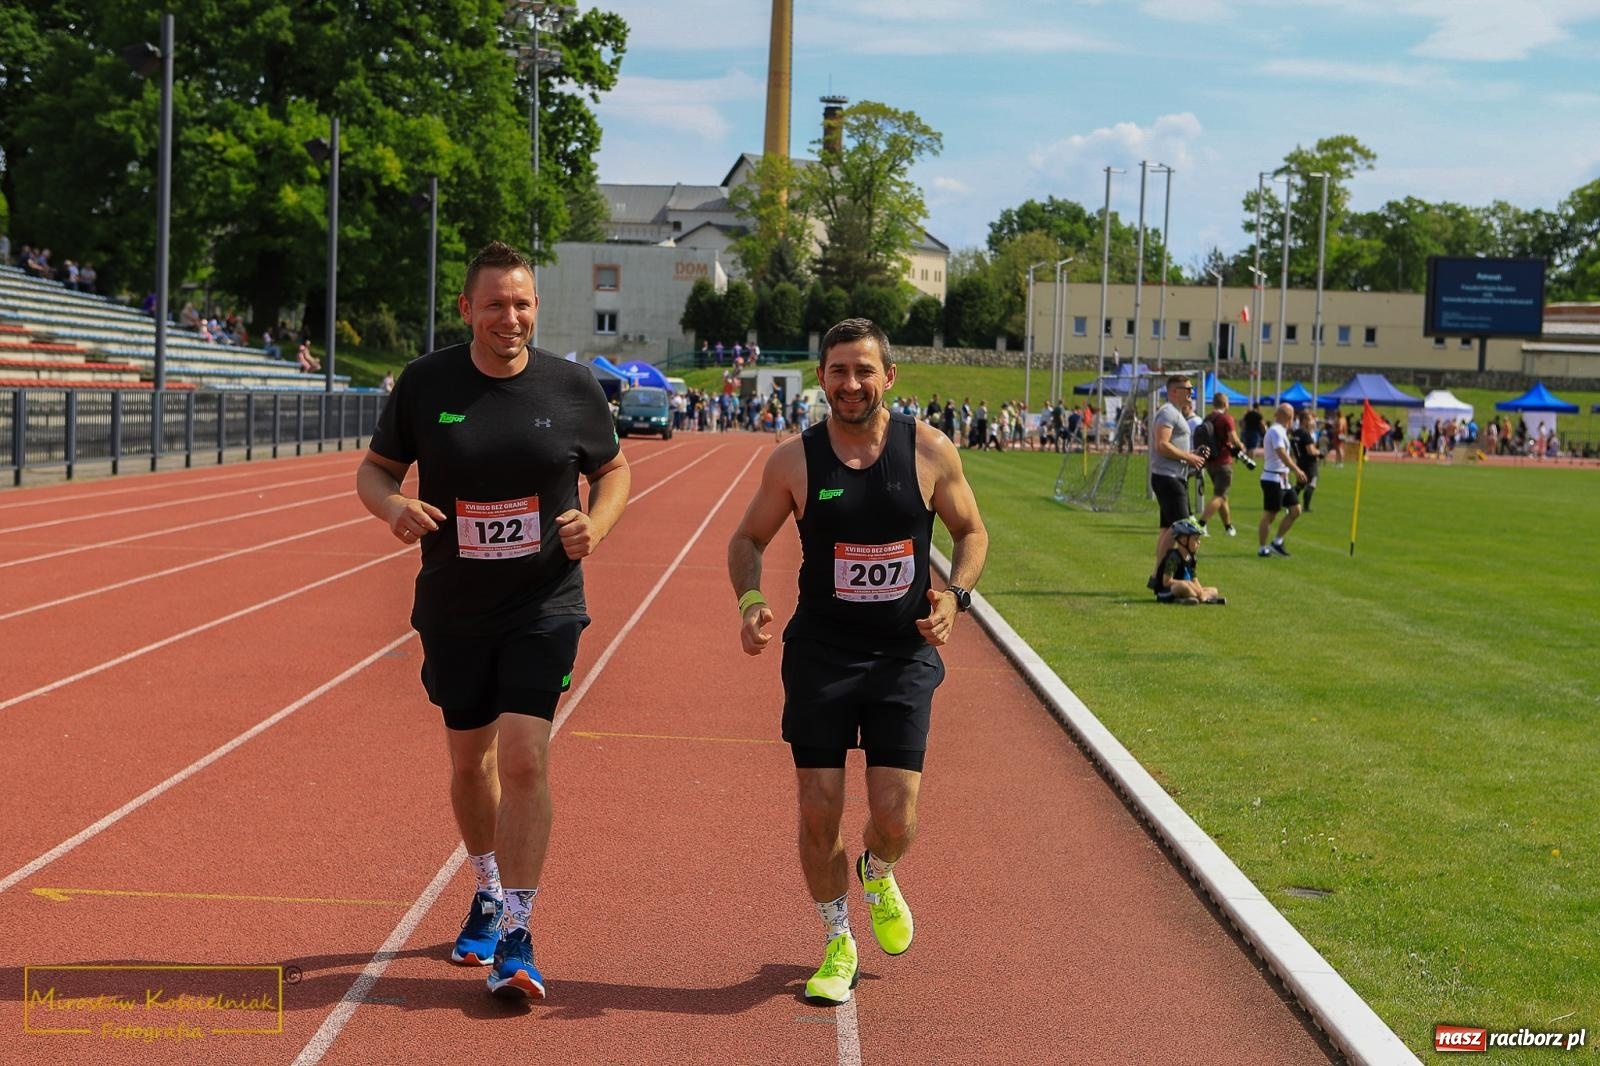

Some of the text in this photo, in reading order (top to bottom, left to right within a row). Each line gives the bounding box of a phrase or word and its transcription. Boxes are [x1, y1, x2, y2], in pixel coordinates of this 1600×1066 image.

[676, 261, 708, 274] DOM
[504, 500, 528, 510] GRANIC
[475, 518, 524, 544] 122
[884, 544, 904, 552] GRANIC
[850, 562, 902, 586] 207
